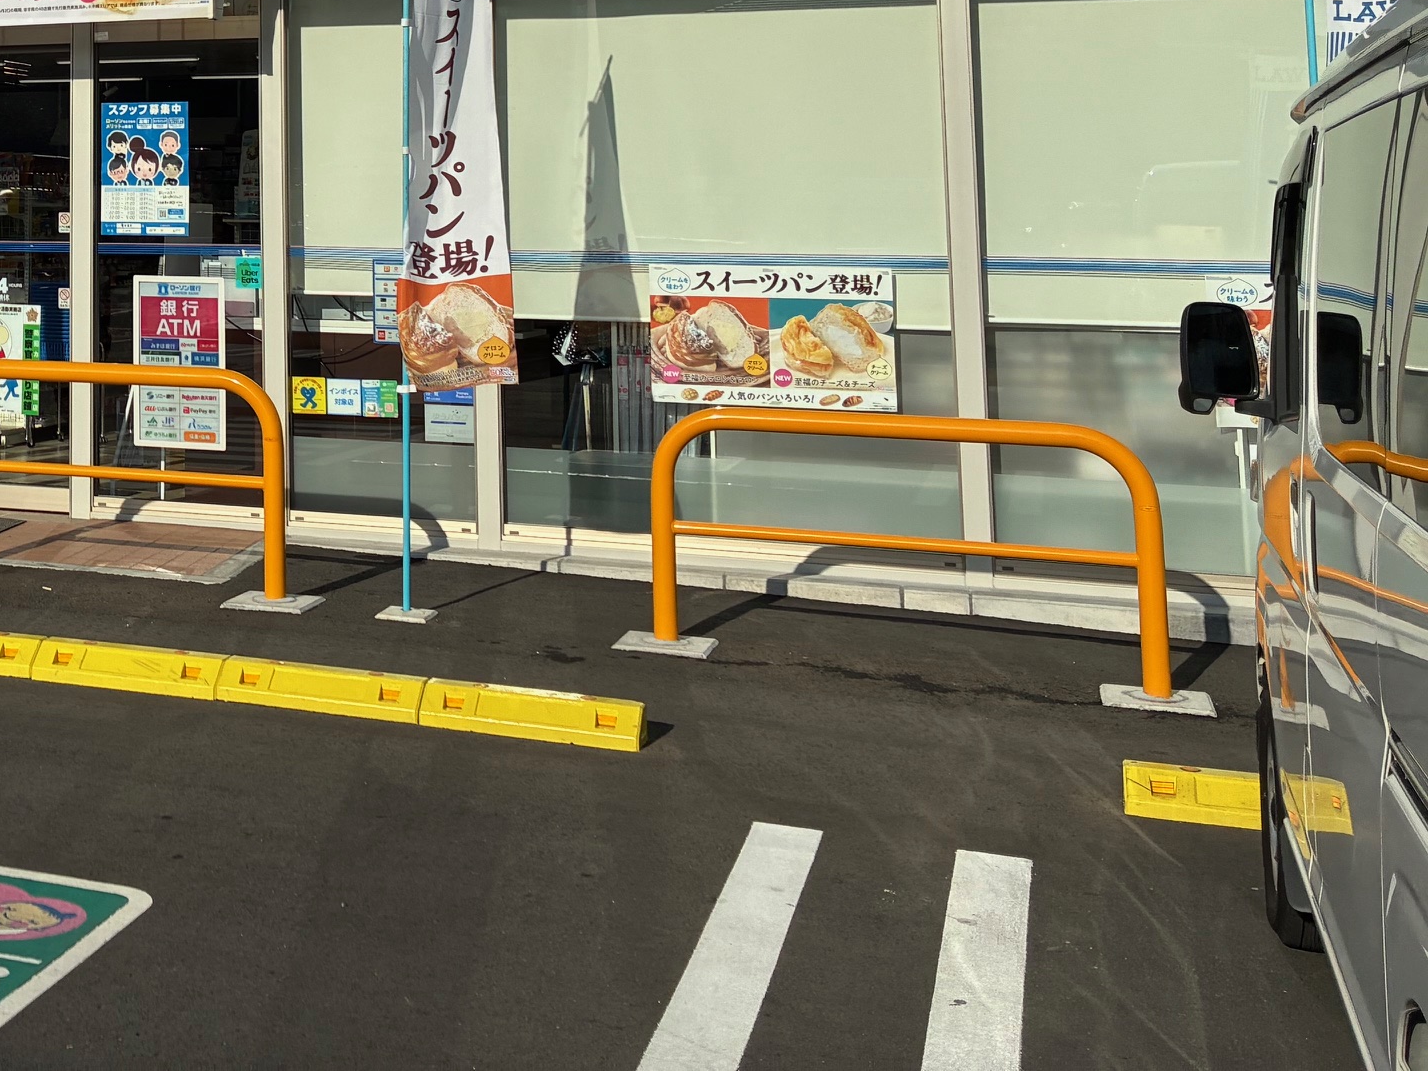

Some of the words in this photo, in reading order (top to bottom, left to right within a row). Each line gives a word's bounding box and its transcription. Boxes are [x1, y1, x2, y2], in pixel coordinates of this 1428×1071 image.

[108, 103, 182, 116] スタッフ募集中
[419, 9, 465, 241] スイーツパン
[410, 236, 495, 281] 登場!
[170, 284, 201, 292] ローソン銀行
[691, 270, 883, 296] スイーツパン登場!
[1219, 287, 1256, 295] クリームを
[1225, 295, 1250, 303] 味わう
[160, 299, 199, 317] 銀行
[156, 318, 201, 337] ATM
[775, 374, 791, 382] NEW
[794, 378, 876, 388] 至福のチーズ&チーズ
[329, 387, 359, 395] インボイス
[727, 390, 815, 403] 人気のパンいろいろ!
[334, 397, 355, 406] 対象店
